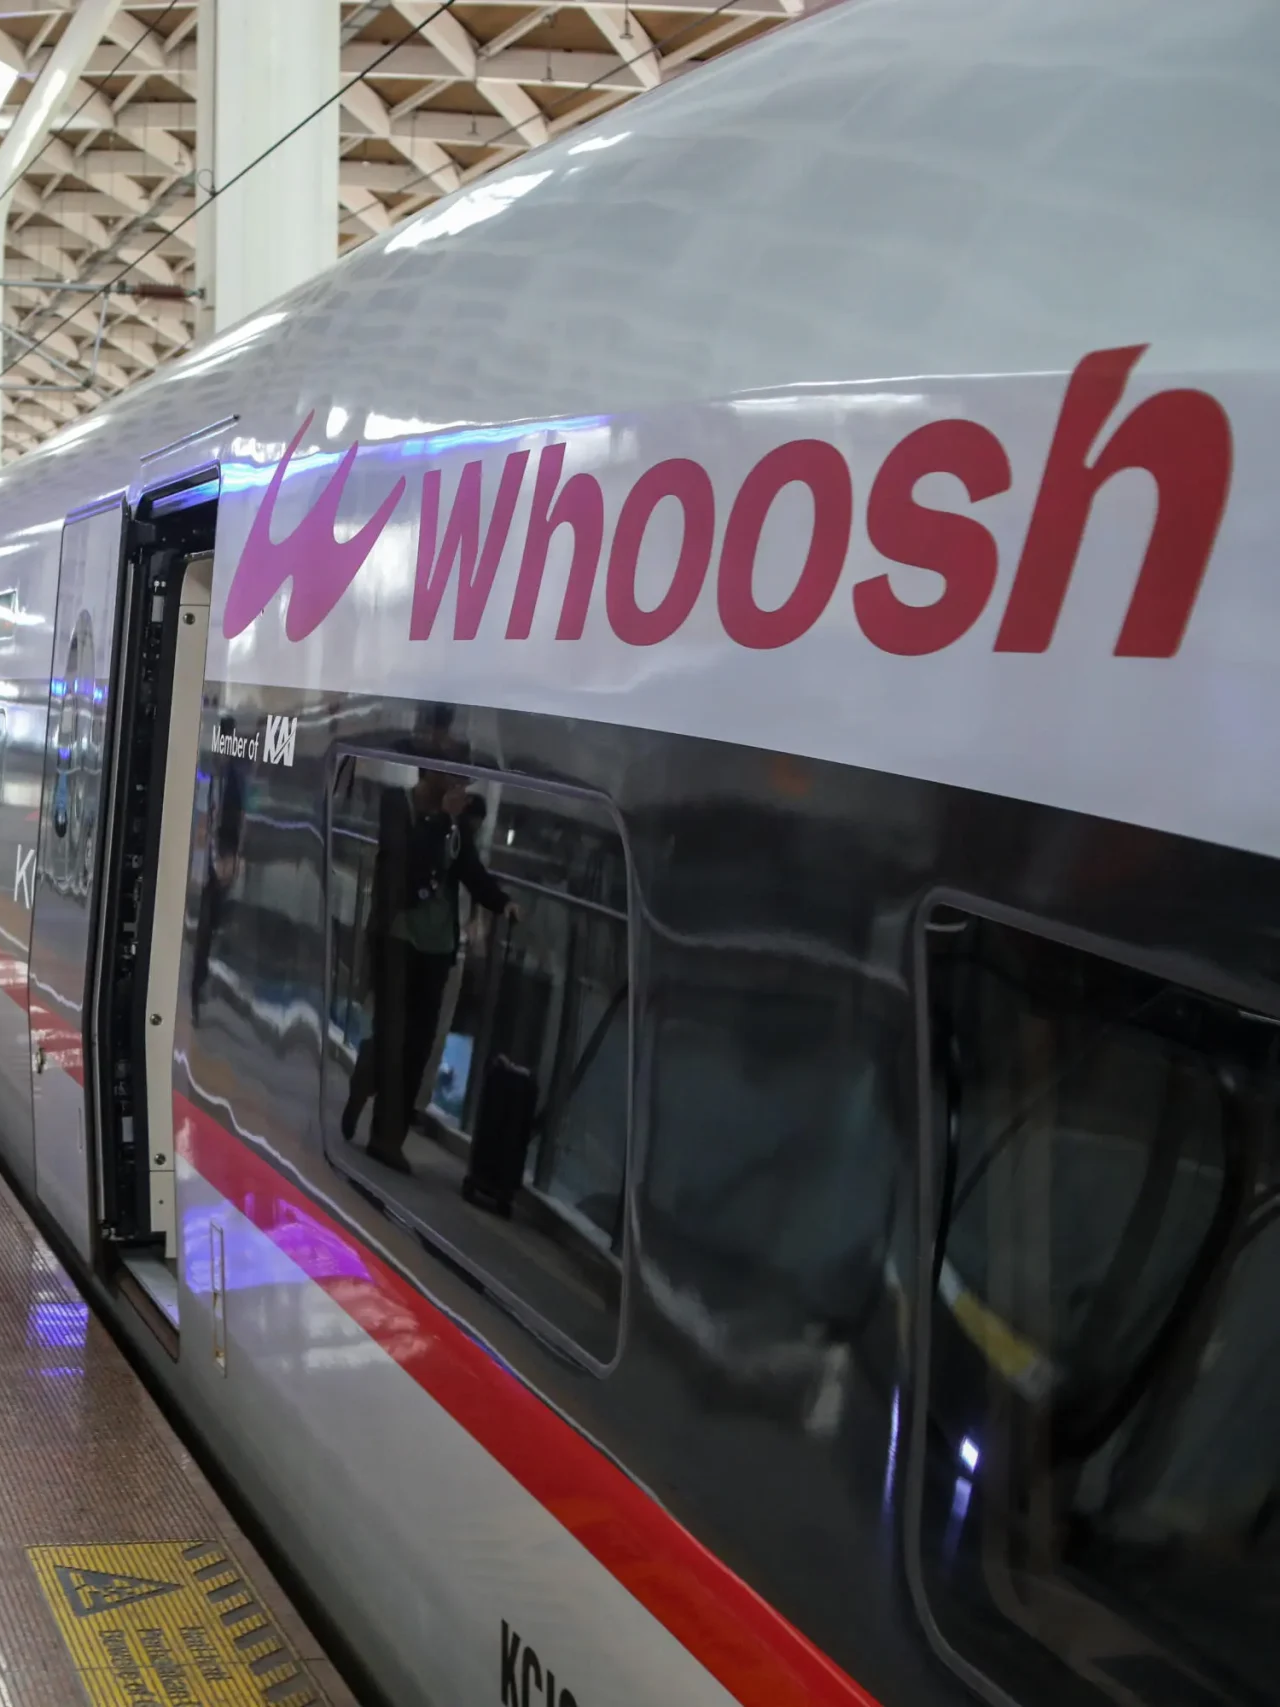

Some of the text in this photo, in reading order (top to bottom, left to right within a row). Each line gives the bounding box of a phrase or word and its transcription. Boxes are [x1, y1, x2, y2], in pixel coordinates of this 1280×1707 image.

[409, 343, 1233, 659] Whoosh
[211, 714, 298, 767] Member of KAI
